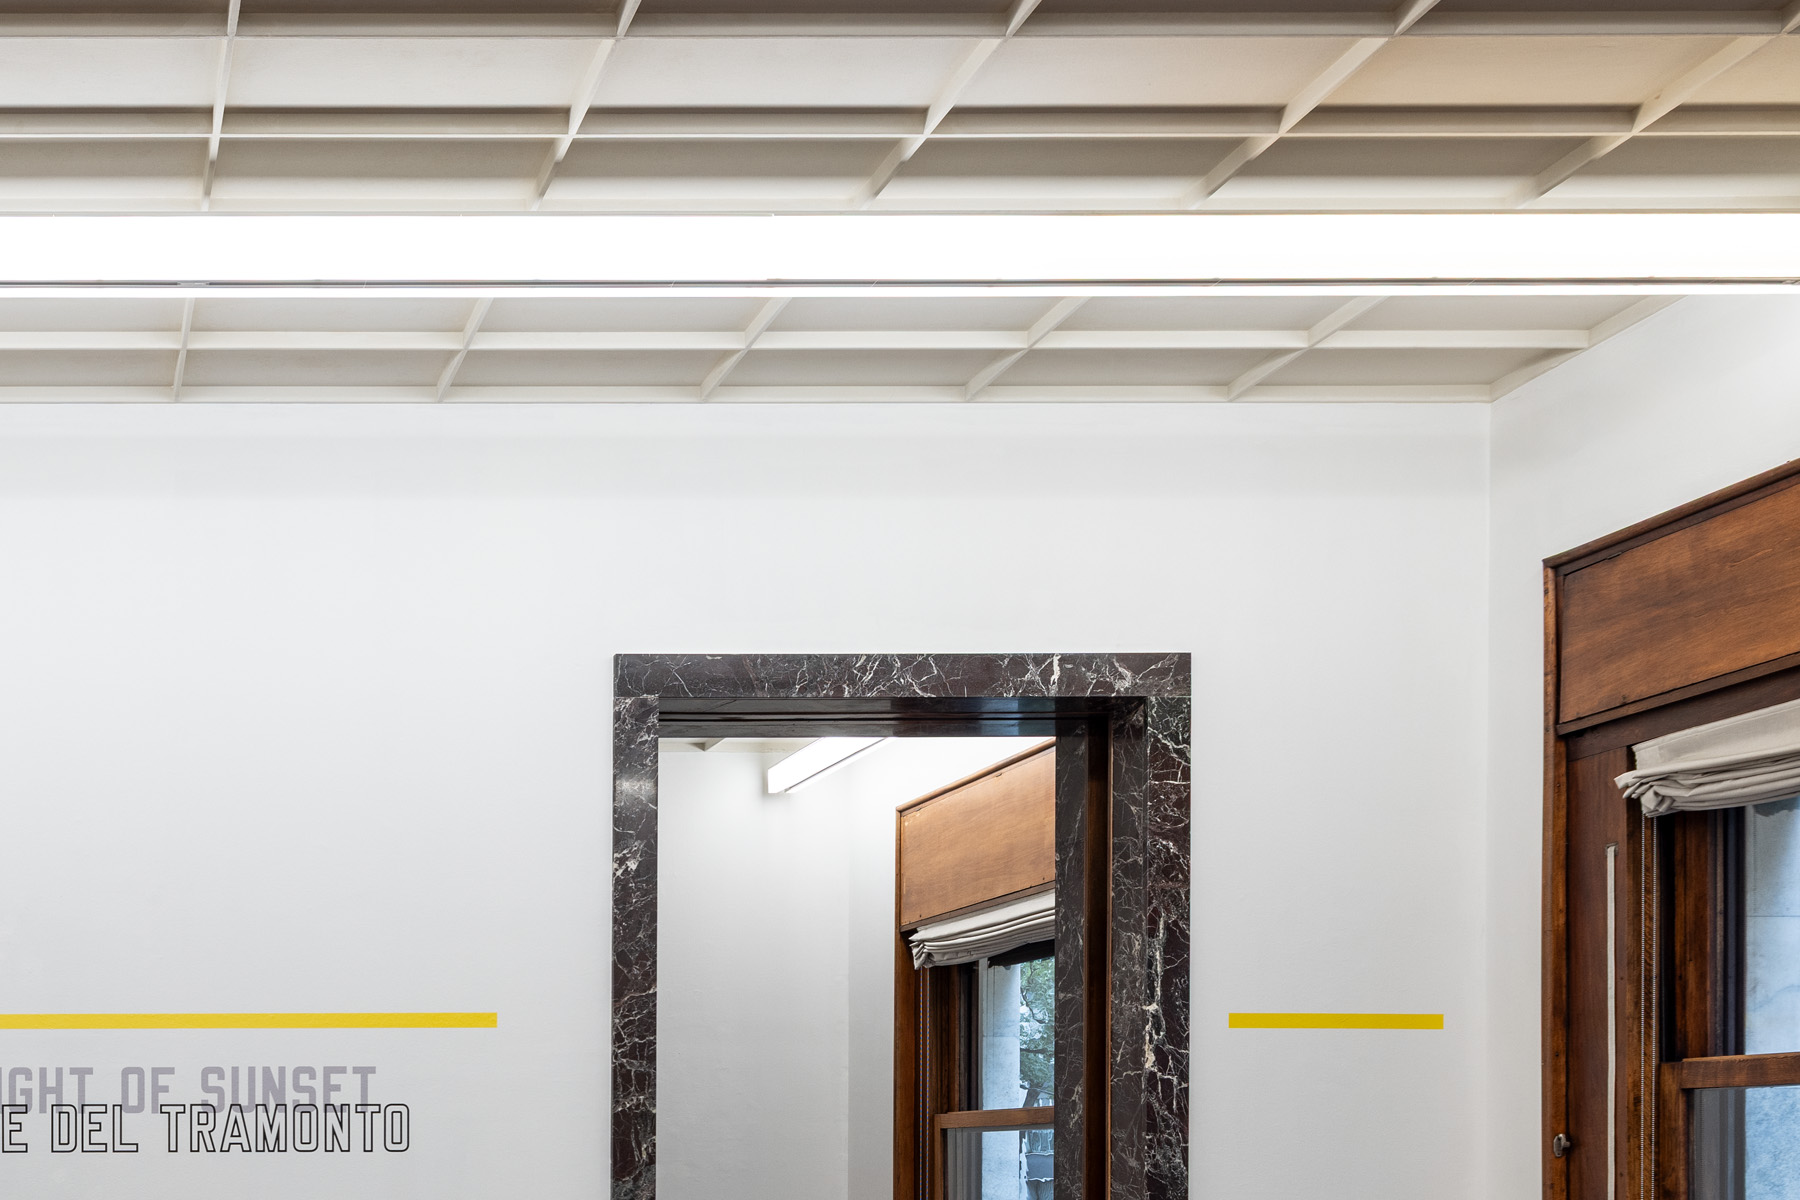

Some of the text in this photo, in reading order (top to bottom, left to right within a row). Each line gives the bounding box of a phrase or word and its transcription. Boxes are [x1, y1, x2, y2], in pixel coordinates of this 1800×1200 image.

[120, 1066, 176, 1114] OF
[200, 1066, 377, 1113] SUNSET
[50, 1104, 139, 1153] DEL
[160, 1103, 411, 1153] TRAMONTO
